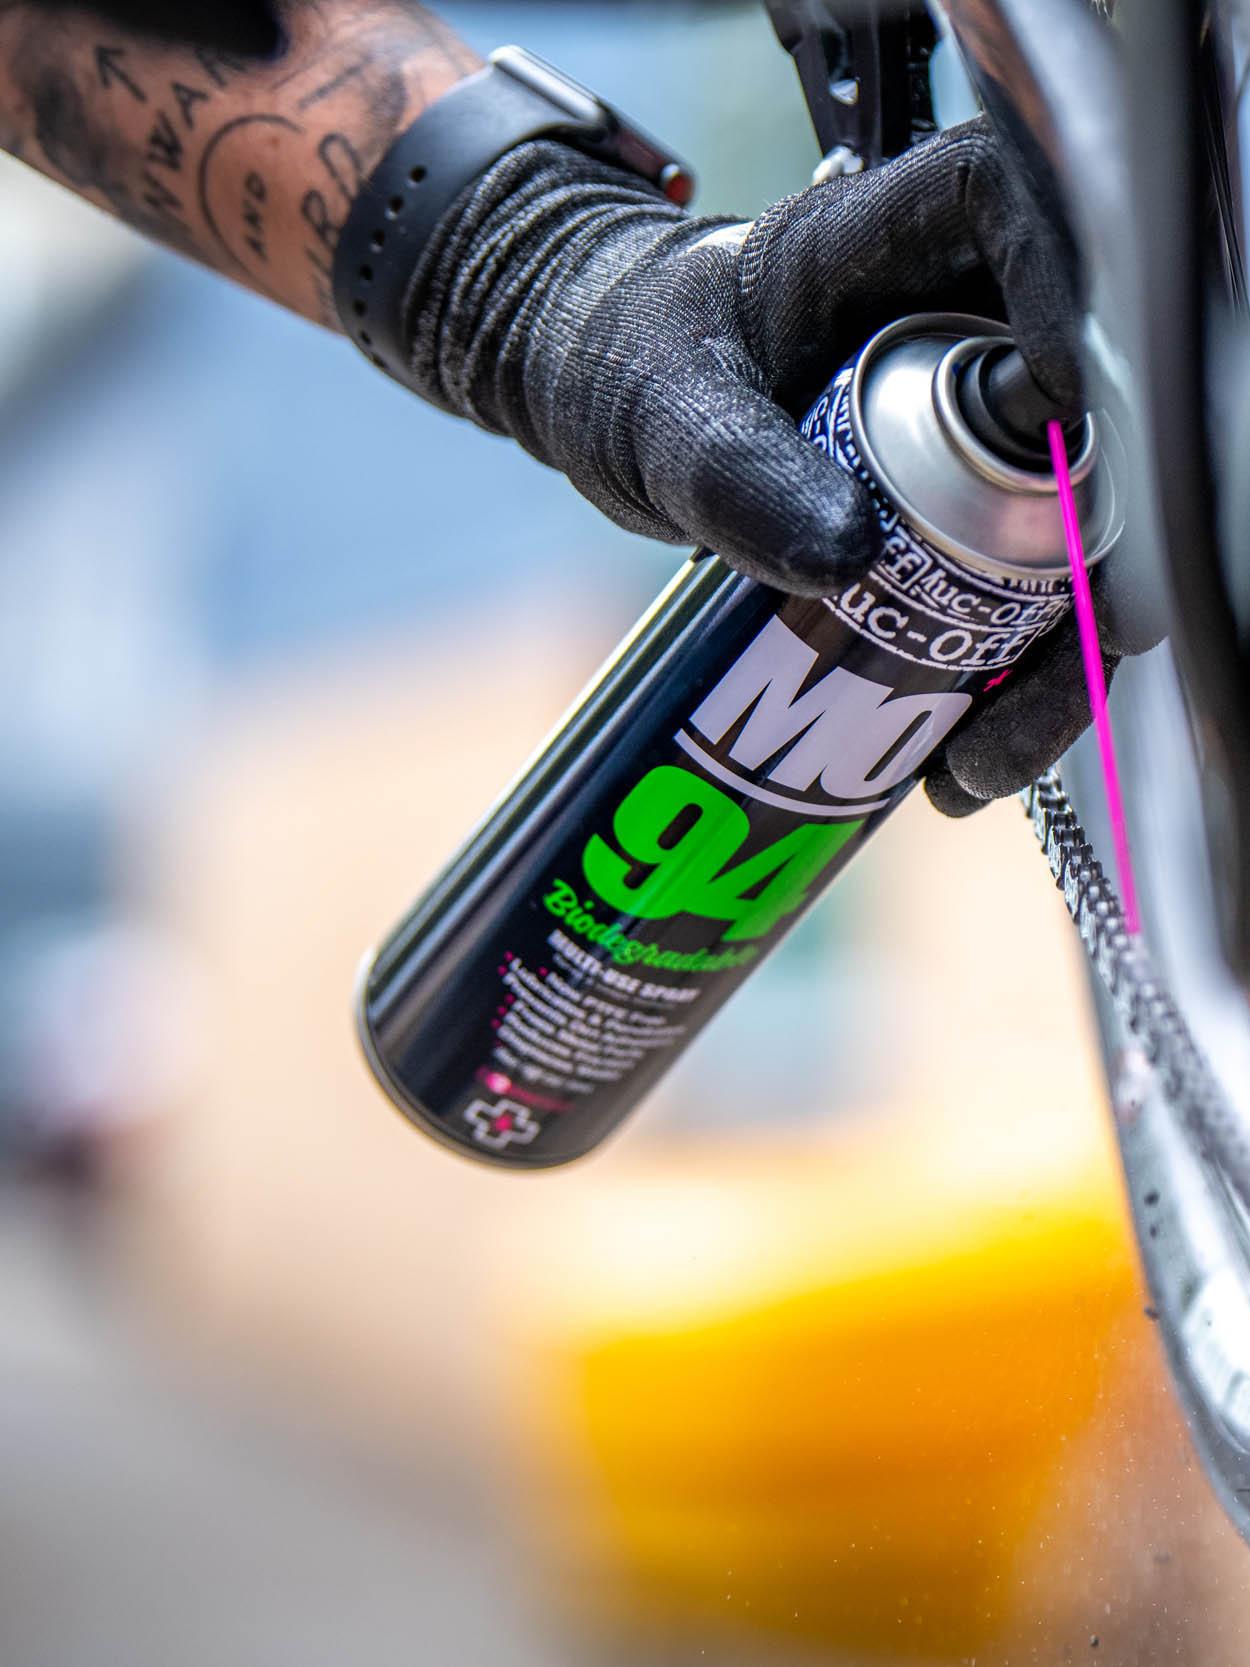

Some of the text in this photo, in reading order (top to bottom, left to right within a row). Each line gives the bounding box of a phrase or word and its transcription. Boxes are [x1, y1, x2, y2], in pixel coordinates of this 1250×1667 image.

[242, 171, 271, 262] AND
[835, 584, 1037, 666] uc-Off
[689, 614, 973, 799] MO
[581, 764, 868, 942] 94
[543, 879, 760, 972] Biodegradable
[547, 929, 642, 994] MULTI-USE
[639, 981, 702, 1004] SPRAY
